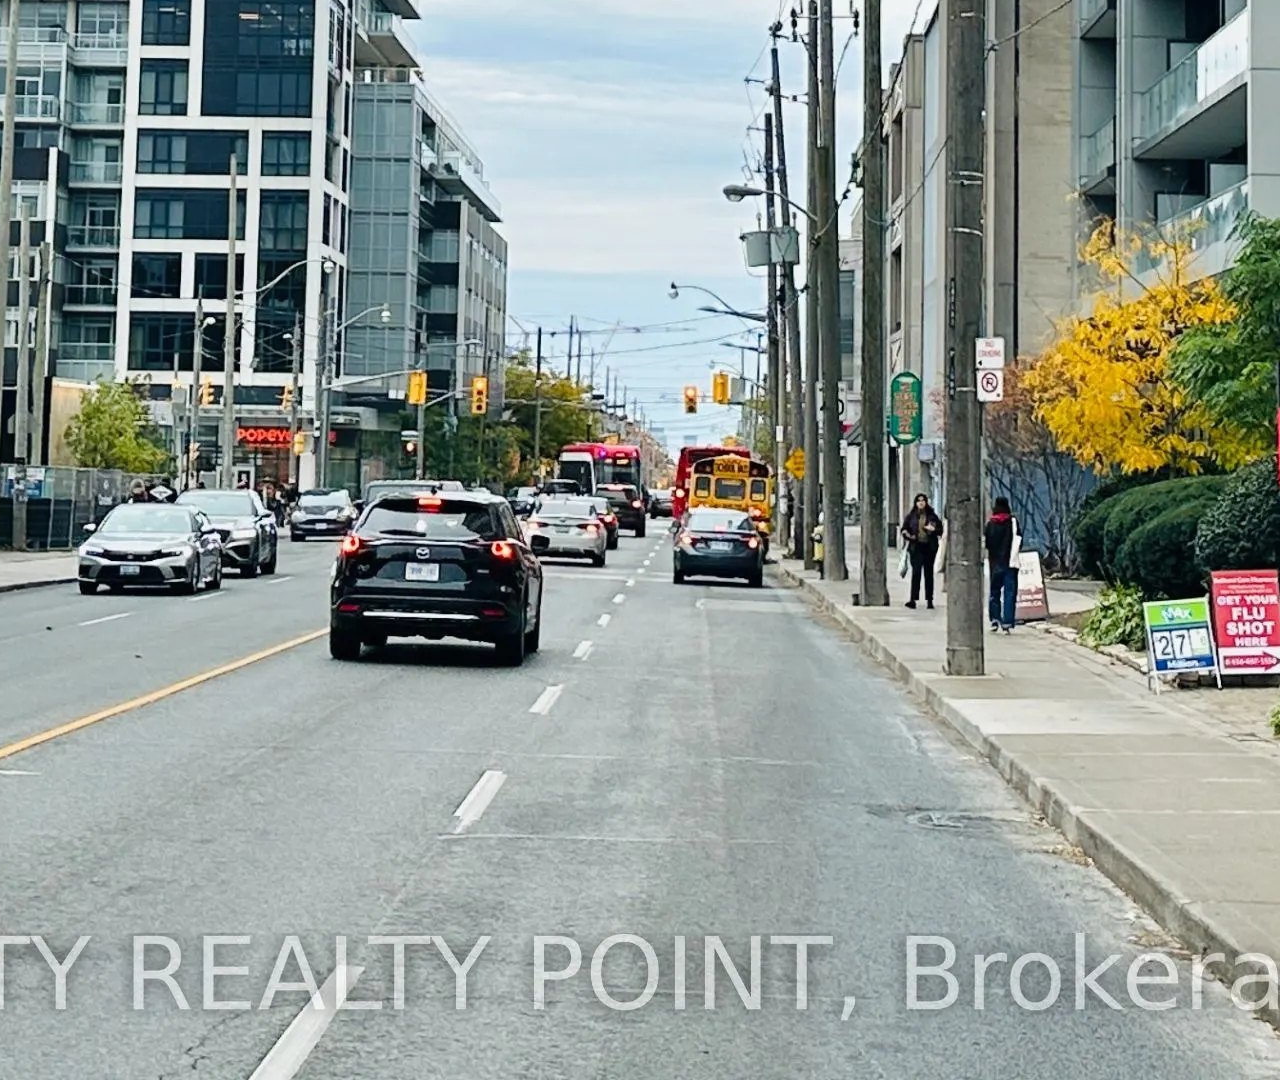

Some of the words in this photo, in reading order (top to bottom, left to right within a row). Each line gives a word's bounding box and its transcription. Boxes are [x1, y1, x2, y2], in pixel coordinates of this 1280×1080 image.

[236, 428, 293, 442] POPEY
[1216, 595, 1241, 606] GET
[1243, 594, 1278, 605] YOUR
[1232, 606, 1266, 620] FLU
[1226, 621, 1275, 636] SHOT
[1234, 637, 1268, 647] HERE
